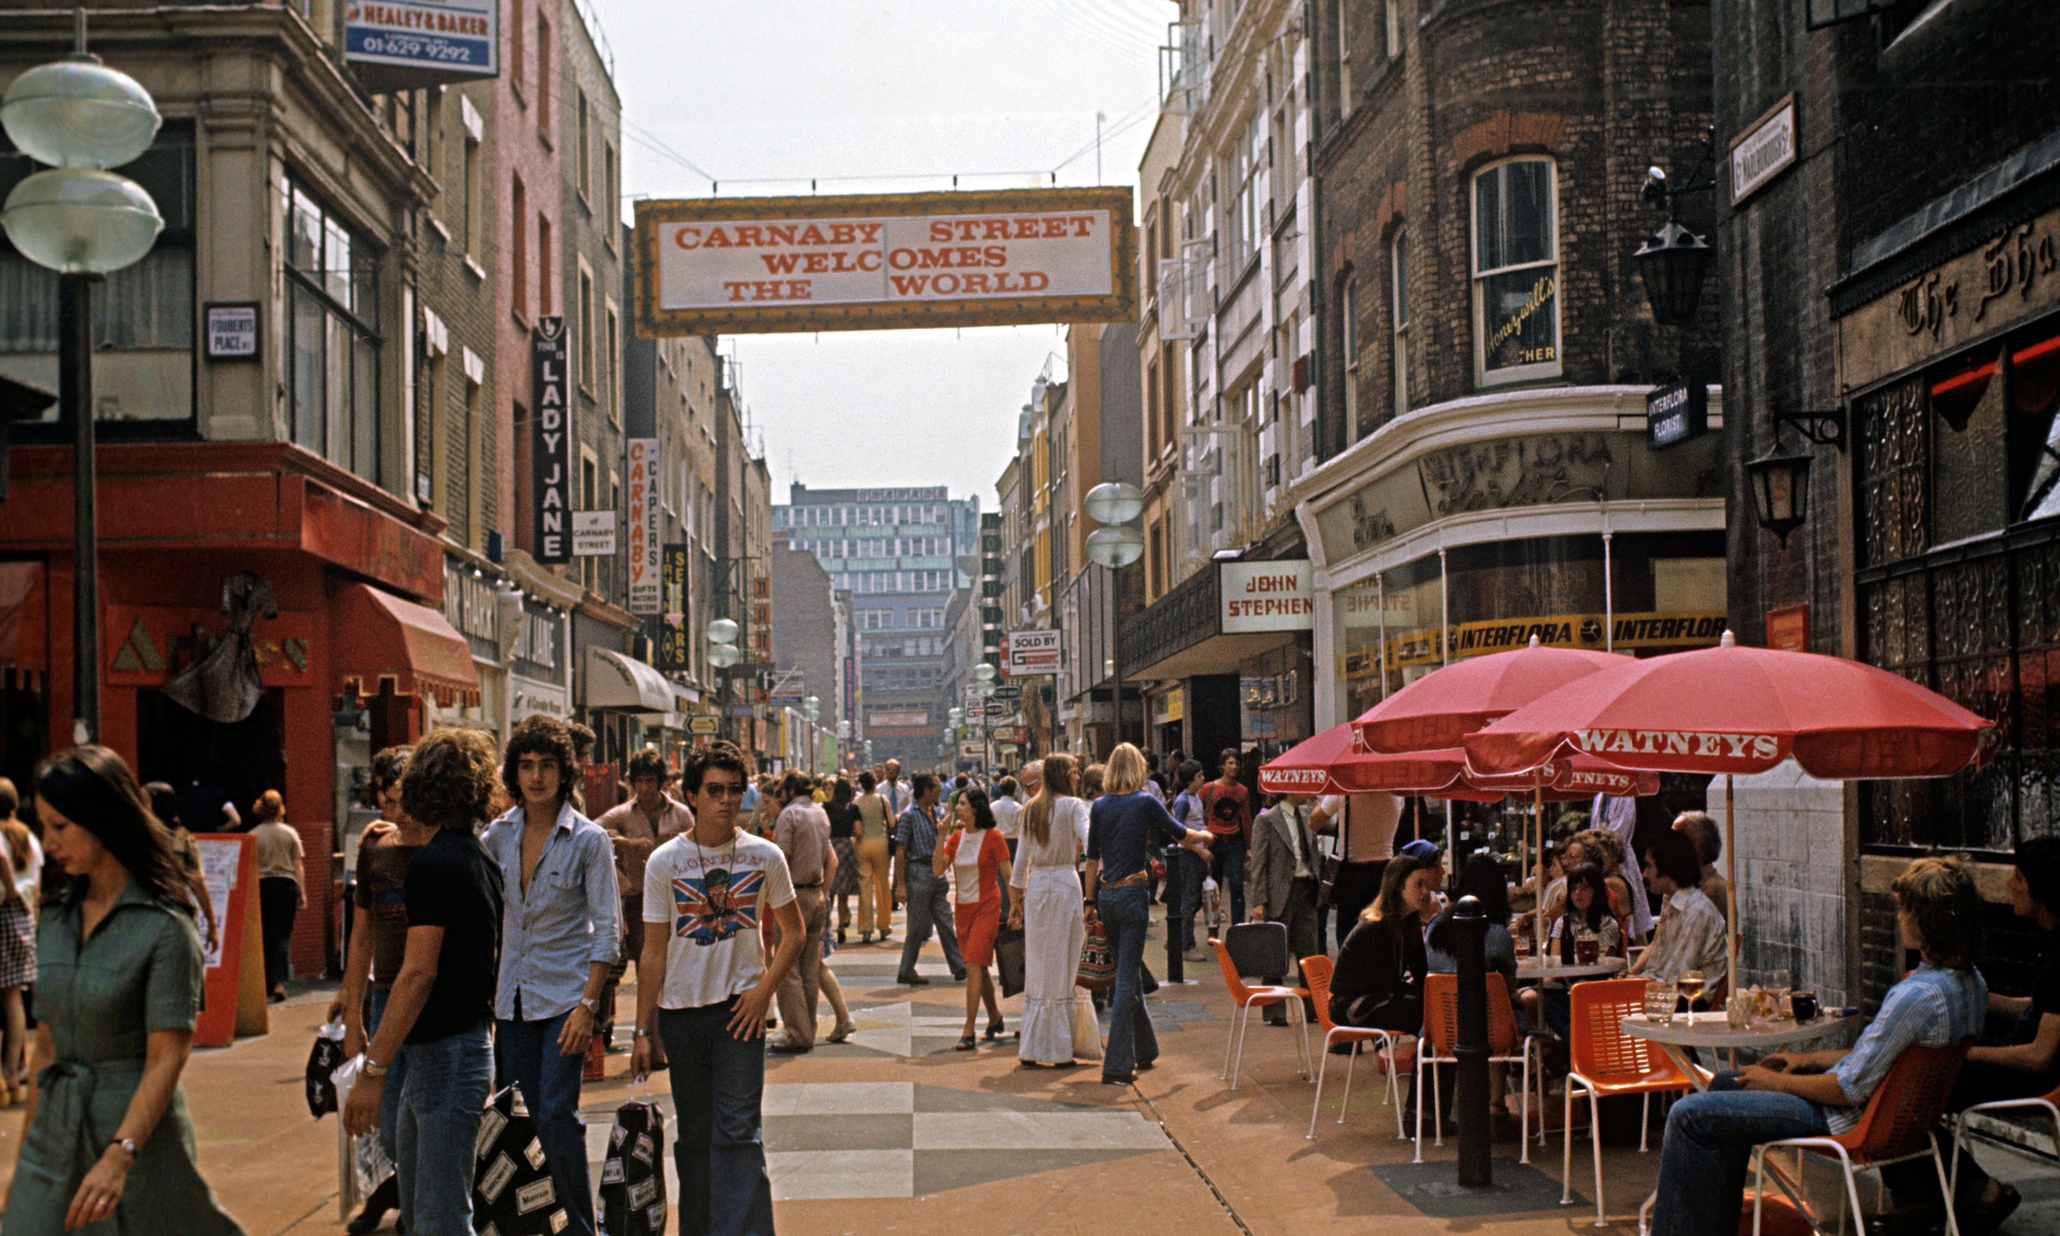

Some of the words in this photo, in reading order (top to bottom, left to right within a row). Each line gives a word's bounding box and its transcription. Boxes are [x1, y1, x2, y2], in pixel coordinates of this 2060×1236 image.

[363, 4, 422, 28] HEALEY
[437, 13, 489, 35] BAKER
[425, 43, 470, 62] 9292
[675, 222, 884, 250] CARNABY
[929, 215, 1096, 243] STREET
[760, 245, 1008, 275] WELCOMES
[723, 279, 813, 302] THE
[890, 271, 1050, 297] WORLD
[214, 335, 241, 350] PLACE
[542, 361, 562, 455] LADY
[543, 464, 562, 557] JANE
[630, 442, 645, 583] CARNABY
[648, 460, 658, 567] CAPERS
[578, 541, 609, 549] STREET
[1245, 574, 1298, 593] JOHN
[1228, 597, 1313, 617] STEPHEN
[1015, 637, 1042, 648] SOLD
[1043, 636, 1056, 646] BY
[1461, 622, 1573, 650] INTERFLORA
[1573, 728, 1779, 761] WATNEYS
[1260, 769, 1327, 784] WATNEYS
